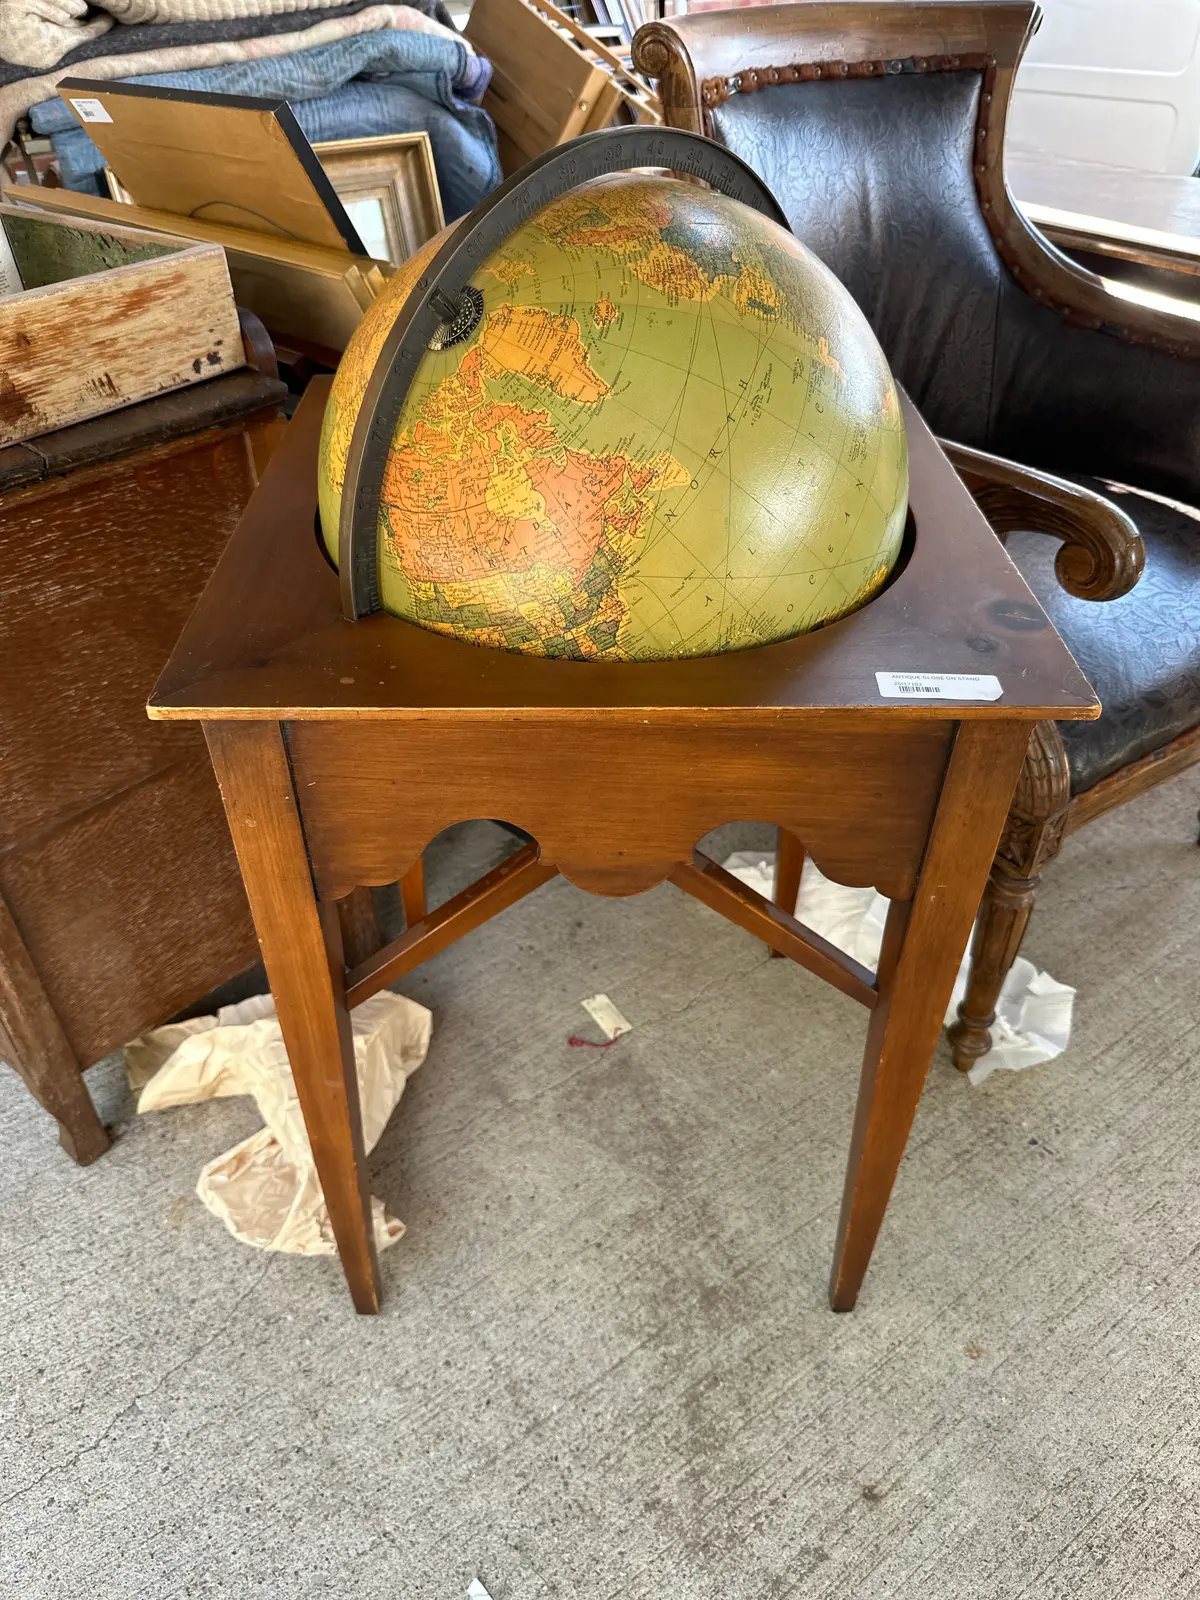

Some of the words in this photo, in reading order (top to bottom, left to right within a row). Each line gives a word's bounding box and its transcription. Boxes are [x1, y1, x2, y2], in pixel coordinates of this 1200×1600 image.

[649, 139, 666, 155] 40
[662, 379, 749, 521] NORTH
[704, 402, 824, 607] ATLANTIC
